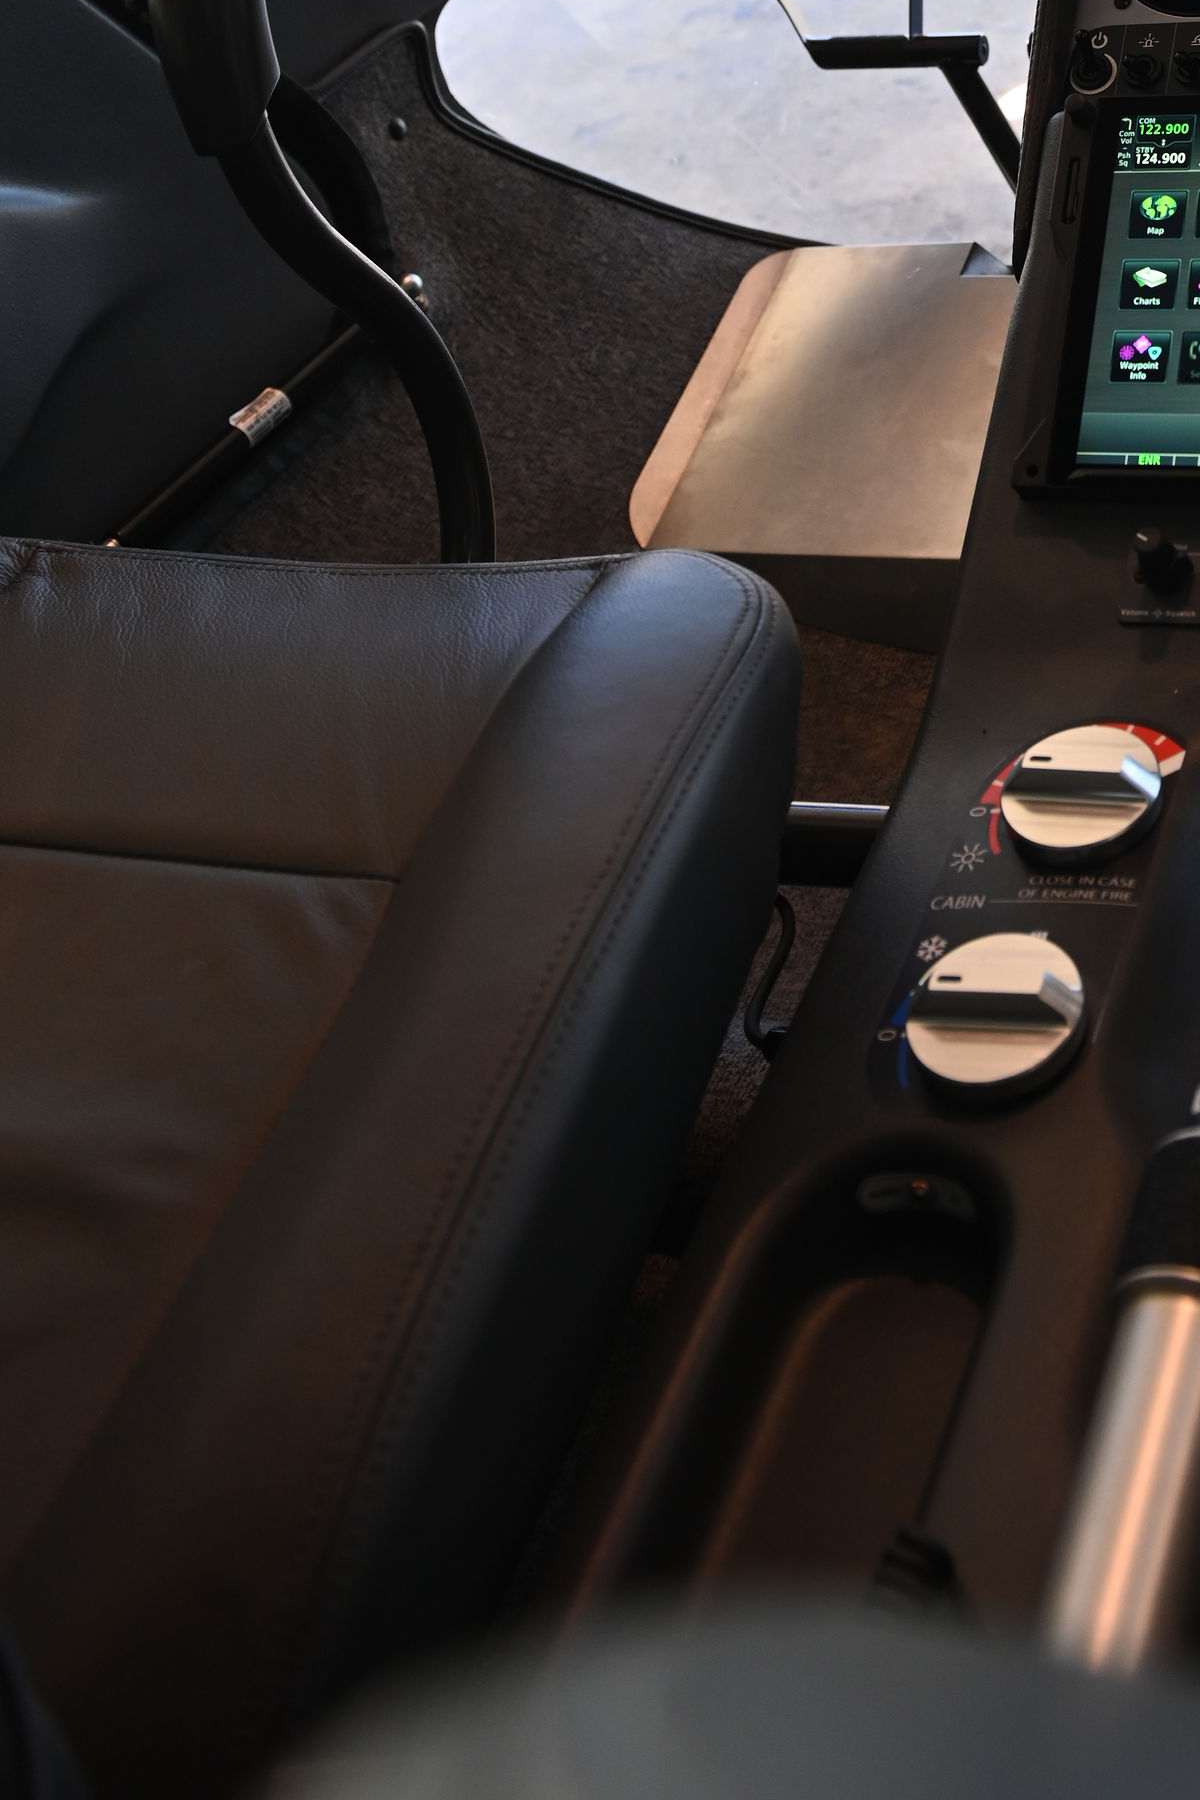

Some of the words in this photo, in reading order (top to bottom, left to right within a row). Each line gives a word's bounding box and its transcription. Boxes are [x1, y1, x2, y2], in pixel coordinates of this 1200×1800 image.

[1140, 123, 1189, 135] 122.900
[1135, 152, 1186, 164] 124.900
[1147, 227, 1165, 236] Map
[1133, 297, 1161, 306] Charts
[1119, 361, 1160, 371] Waypoint
[1129, 371, 1147, 380] Info
[1138, 454, 1161, 466] ENR
[1121, 608, 1149, 617] Volume
[1029, 875, 1074, 886] CLOSE
[1078, 876, 1095, 886] IN
[1098, 877, 1137, 889] CASE
[1018, 889, 1040, 899] OF
[1042, 889, 1099, 900] ENGINE
[1101, 891, 1133, 901] FIRE
[930, 894, 987, 910] CABIN
